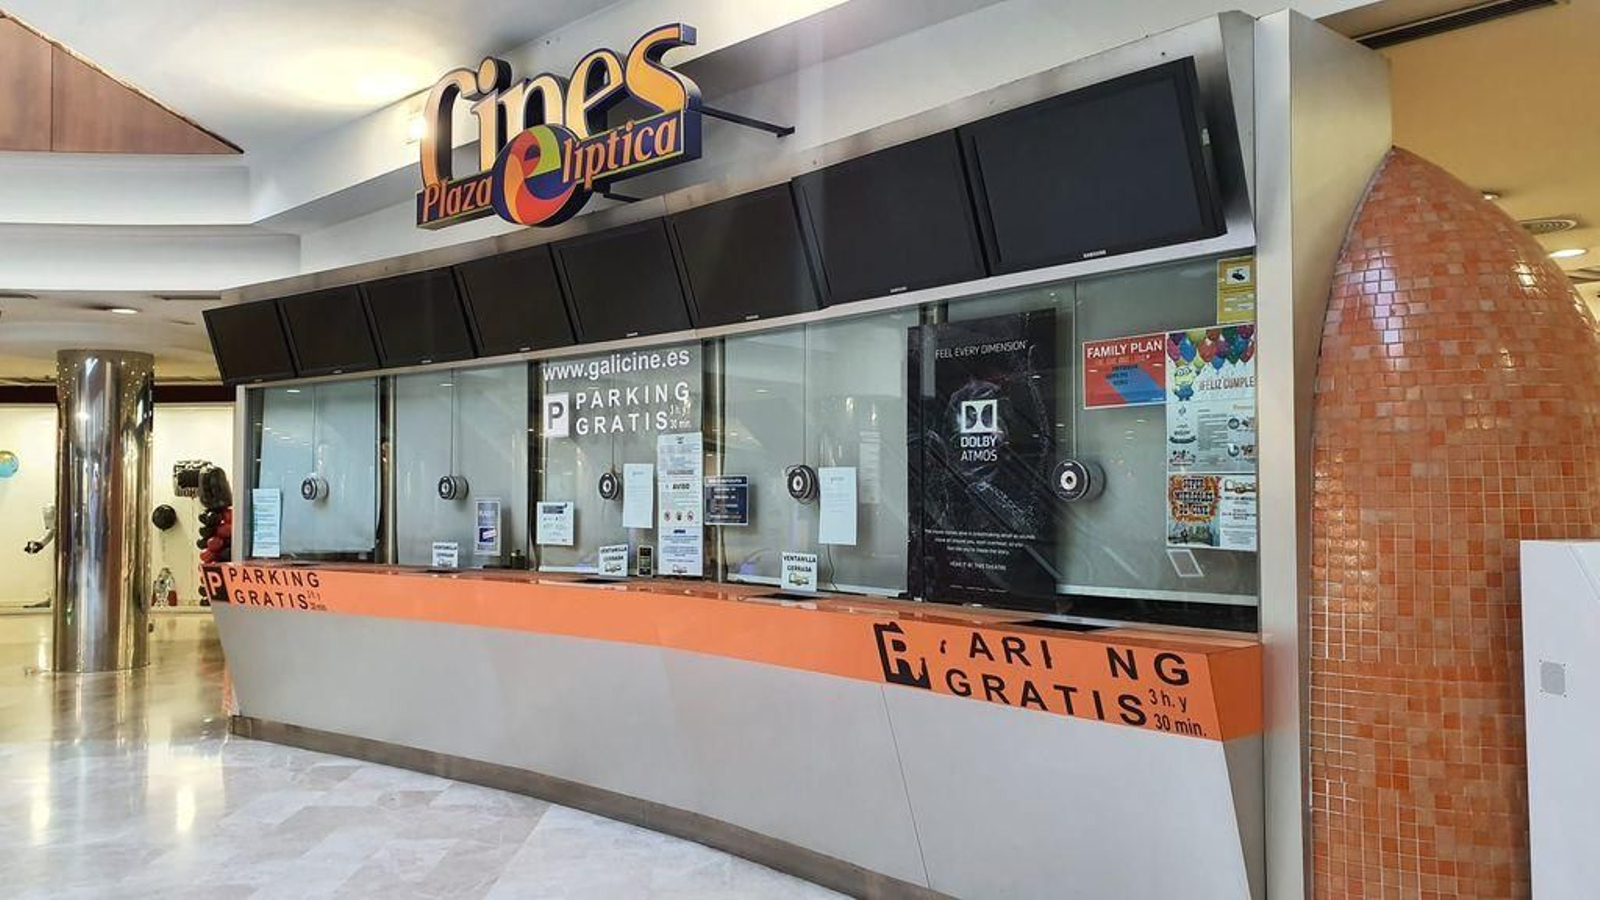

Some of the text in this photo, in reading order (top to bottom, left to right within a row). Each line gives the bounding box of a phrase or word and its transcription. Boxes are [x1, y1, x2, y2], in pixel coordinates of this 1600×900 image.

[420, 23, 690, 188] Cines
[422, 177, 493, 222] Plaza
[934, 348, 953, 359] FEEL
[955, 345, 980, 357] EVERY
[1086, 343, 1127, 359] FAMILY
[1130, 339, 1163, 354] PLAN
[542, 349, 690, 381] www.galicine.es
[575, 381, 690, 410] PARKING
[547, 401, 565, 431] P
[575, 411, 668, 435] GRATIS
[960, 436, 998, 448] DOLBY
[960, 450, 998, 462] ATMOS
[783, 555, 816, 563] VENTANILLA
[787, 565, 812, 573] CERRADA
[207, 571, 222, 596] P
[228, 568, 320, 588] PARKING
[234, 589, 309, 610] GRATIS
[945, 668, 1147, 727] GRATIS
[1149, 688, 1187, 713] 3 h. y
[1153, 714, 1208, 737] 30 min.
